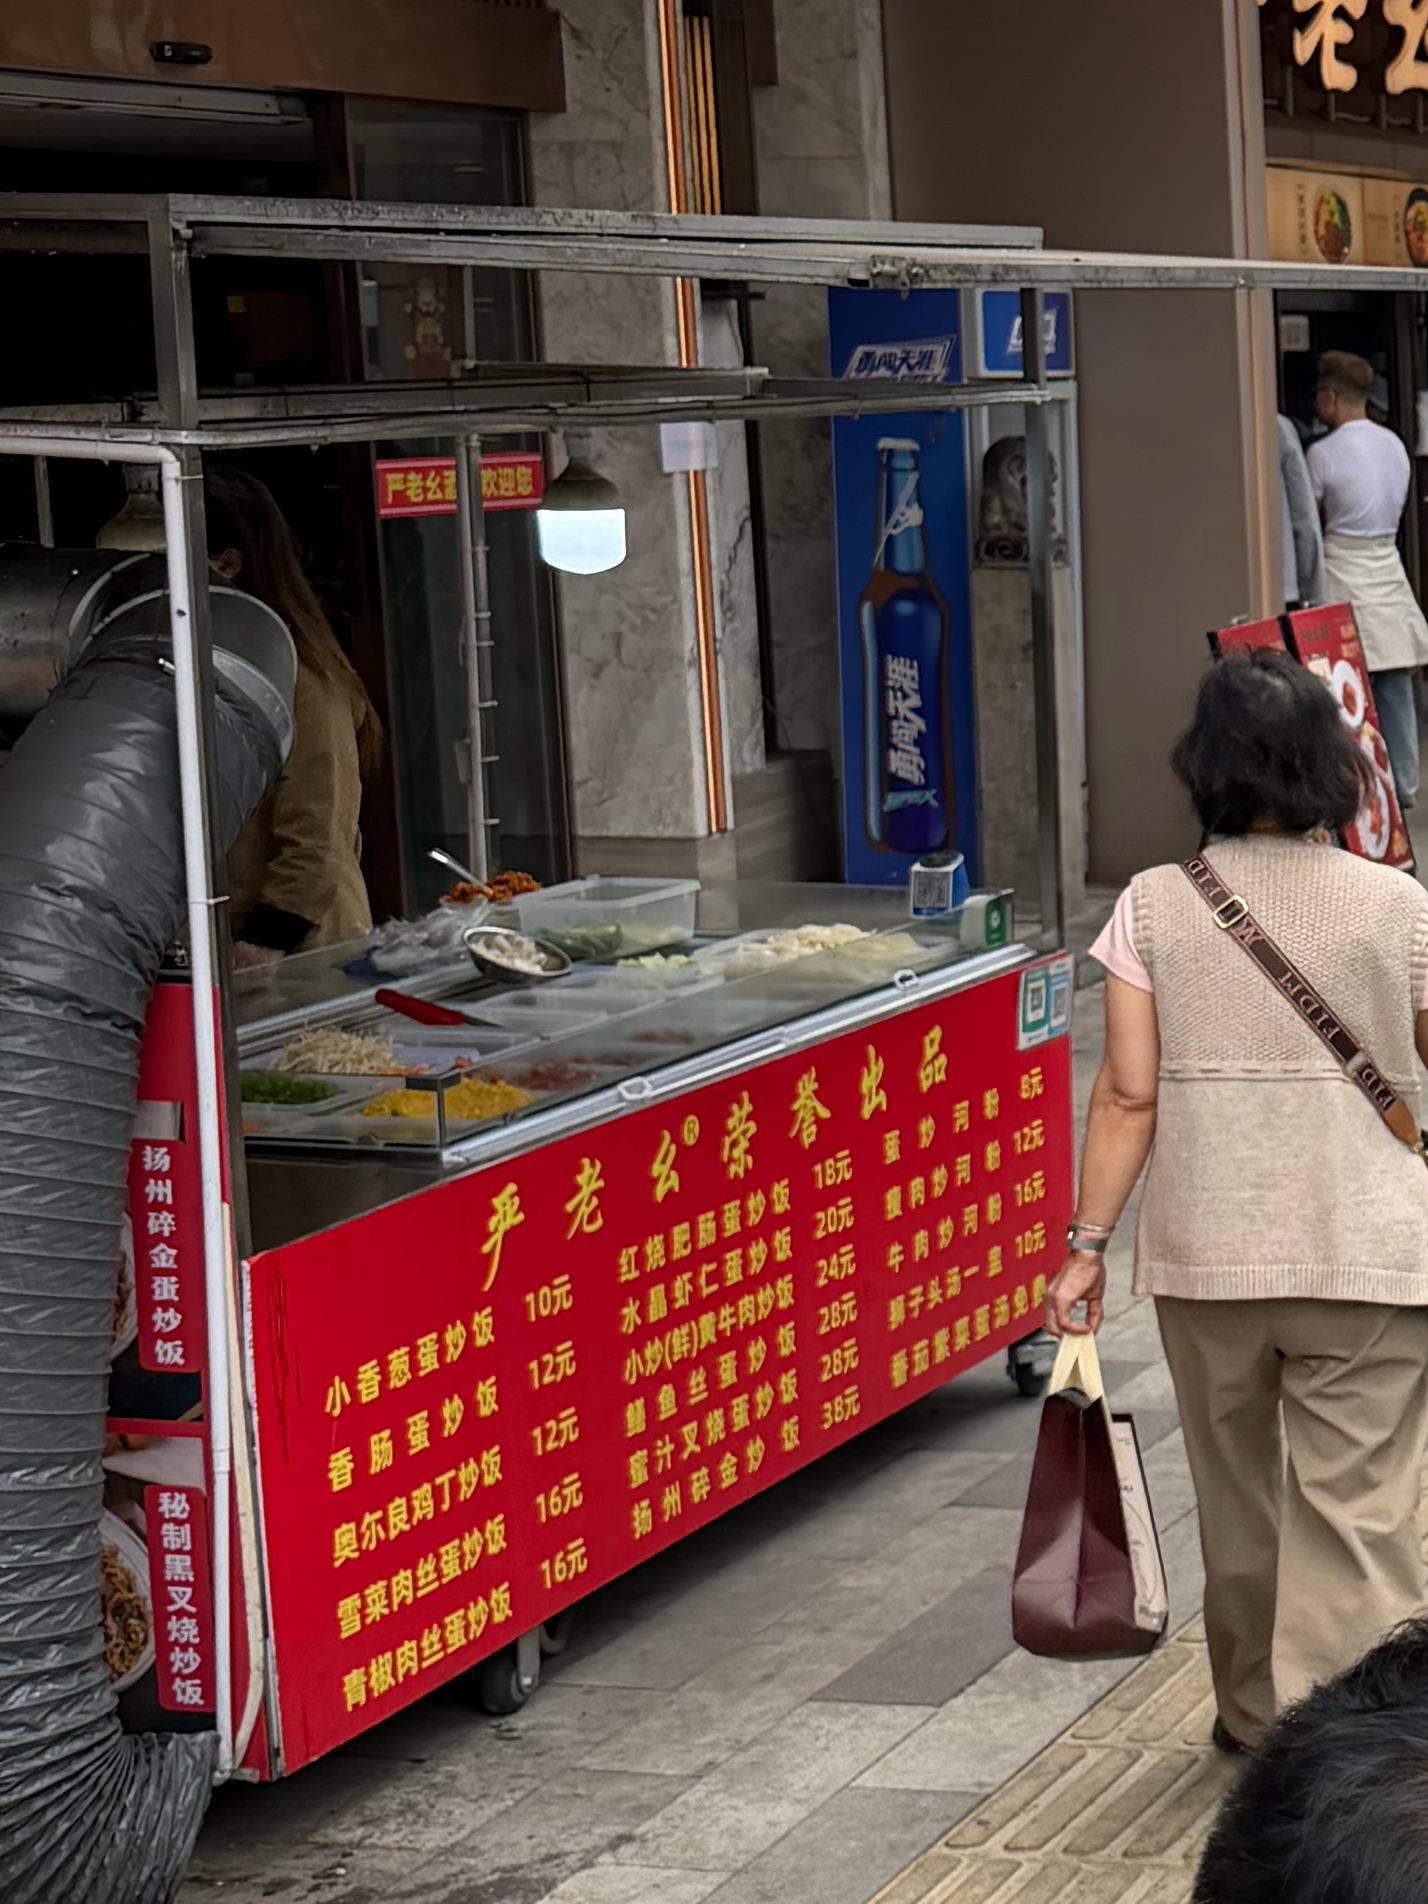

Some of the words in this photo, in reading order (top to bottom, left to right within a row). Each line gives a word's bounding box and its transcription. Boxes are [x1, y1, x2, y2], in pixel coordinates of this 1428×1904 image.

[385, 464, 534, 504] 严老幺酒欢迎您
[886, 654, 927, 786] 勇闯天涯
[883, 1088, 999, 1165] 蛋炒河粉
[1013, 1119, 1045, 1154] 12元
[141, 1145, 185, 1366] 扬州碎金蛋炒饭
[617, 1178, 791, 1283] 红烧肥肠蛋炒饭
[812, 1149, 853, 1190] 18元
[619, 1226, 793, 1335] 水晶虾仁蛋炒饭
[814, 1196, 854, 1240] 20元
[815, 1243, 856, 1288] 24元
[887, 1193, 1002, 1273] 牛肉炒河粉
[1014, 1170, 1046, 1207] 16元
[1015, 1221, 1047, 1258] 10元
[324, 1306, 496, 1418] 小香葱蛋炒饭
[525, 1274, 575, 1322] 10元
[817, 1290, 858, 1335] 28元
[328, 1376, 499, 1493] 香肠蛋炒饭
[528, 1340, 577, 1390] 12元
[627, 1368, 799, 1489] 蜜汁叉烧蛋炒饭
[819, 1337, 859, 1383] 28元
[631, 1415, 801, 1539] 扬州碎金炒饭
[822, 1384, 861, 1430] 38元
[332, 1444, 503, 1567] 奥尔良鸡丁炒饭
[532, 1406, 580, 1457] 12元
[337, 1513, 507, 1640] 雪菜肉丝蛋炒饭
[535, 1471, 584, 1523] 16元
[158, 1492, 204, 1705] 秘制黑叉烧炒饭
[342, 1582, 513, 1713] 青椒肉丝蛋炒饭
[540, 1537, 588, 1591] 16元
